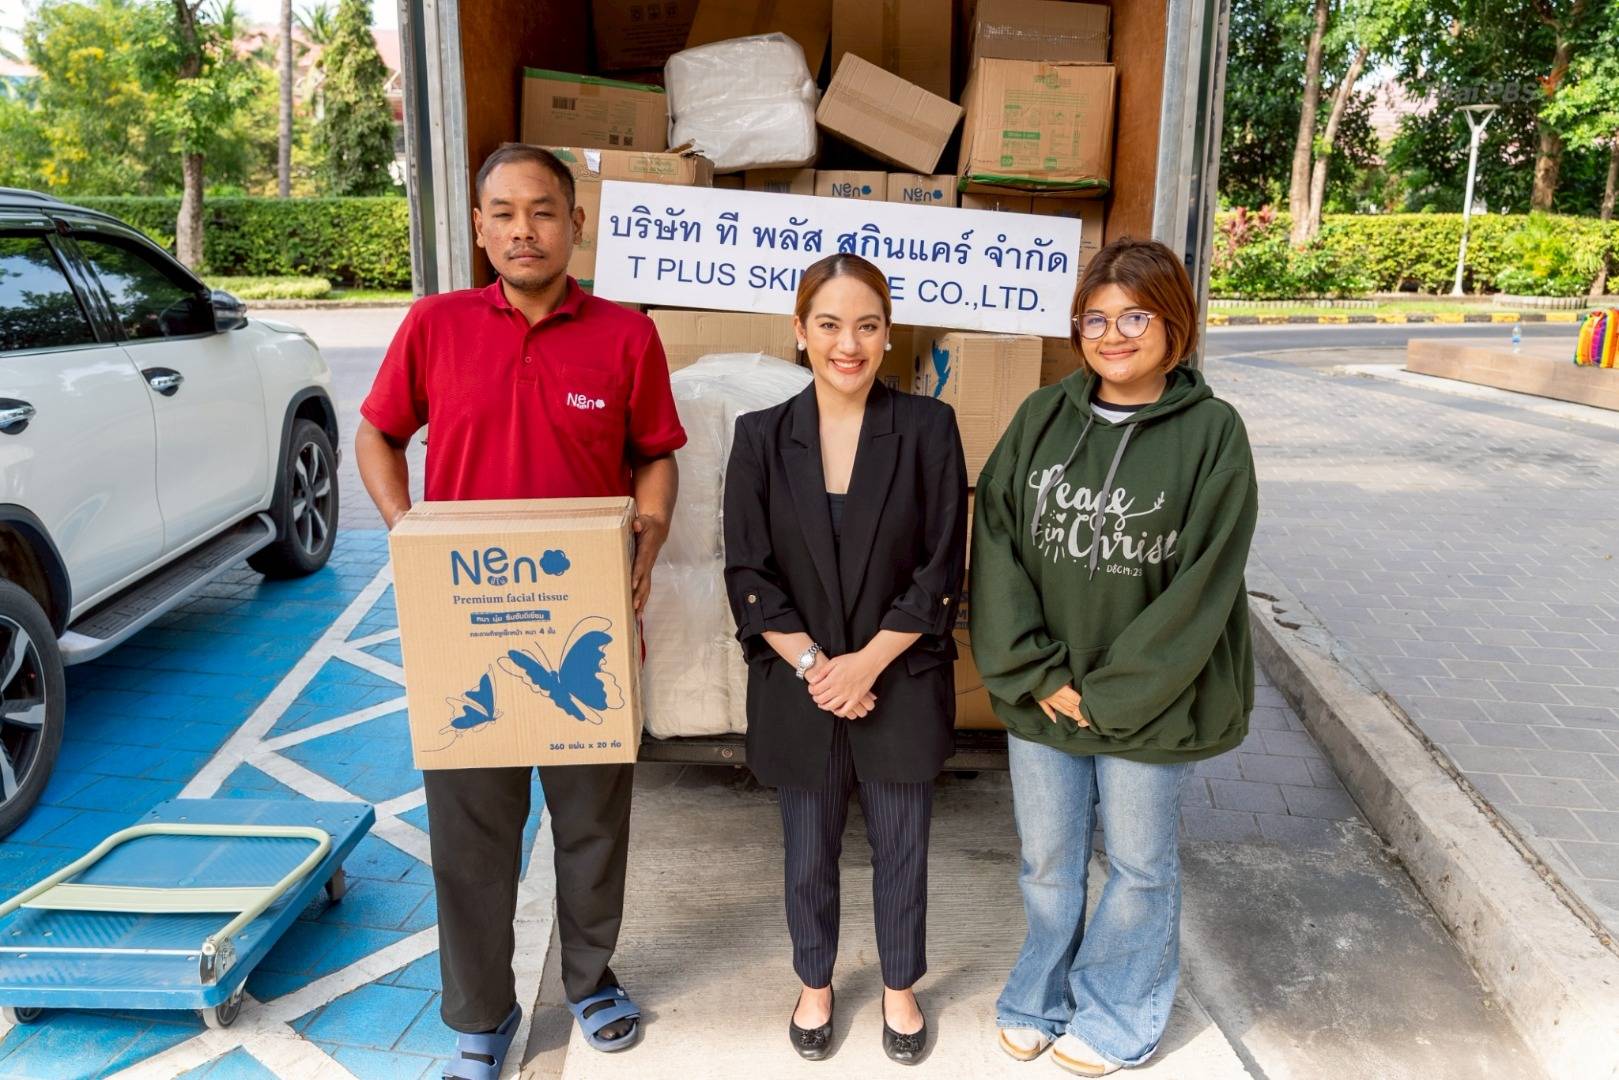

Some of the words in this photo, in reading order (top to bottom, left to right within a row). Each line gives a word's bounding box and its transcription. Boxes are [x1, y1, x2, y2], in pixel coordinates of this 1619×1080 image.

[609, 205, 701, 243] บริษัท
[716, 211, 739, 246] ที
[752, 216, 822, 253] พลัส
[837, 222, 974, 265] สกินแคร์
[984, 233, 1068, 274] จำกัด
[627, 255, 646, 279] T
[656, 257, 736, 287] PLUS
[1044, 523, 1065, 543] in
[453, 595, 503, 605] Premium
[506, 592, 535, 603] facial
[538, 592, 569, 602] tissue
